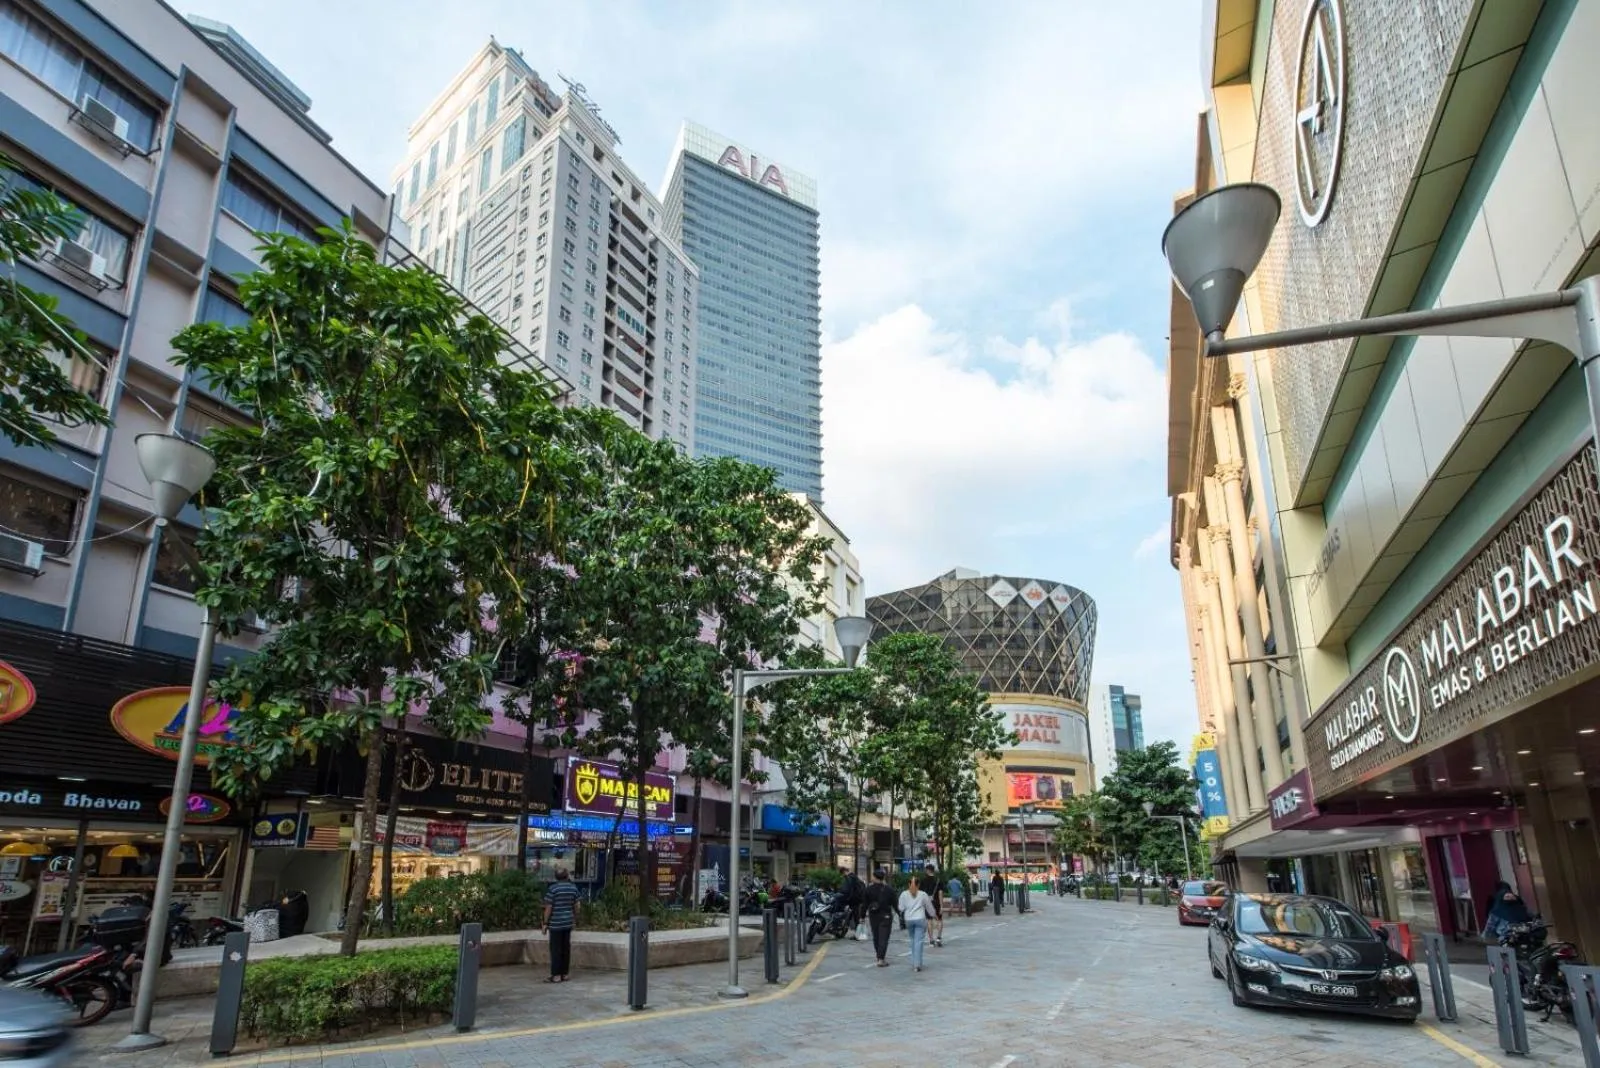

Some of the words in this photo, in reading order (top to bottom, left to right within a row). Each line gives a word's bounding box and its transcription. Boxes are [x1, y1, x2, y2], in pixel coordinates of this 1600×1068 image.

[717, 145, 789, 196] AIA
[1421, 515, 1584, 677] MALABAR
[1430, 666, 1471, 710] EMAS
[1474, 656, 1488, 682] &
[1491, 581, 1597, 673] BERLIAN
[1013, 713, 1061, 729] JAKEL
[1015, 728, 1061, 745] MALL
[1325, 685, 1380, 752] MALABAR
[440, 763, 525, 794] ELITE
[1204, 762, 1222, 802] 50%
[63, 792, 142, 811] Bhavan
